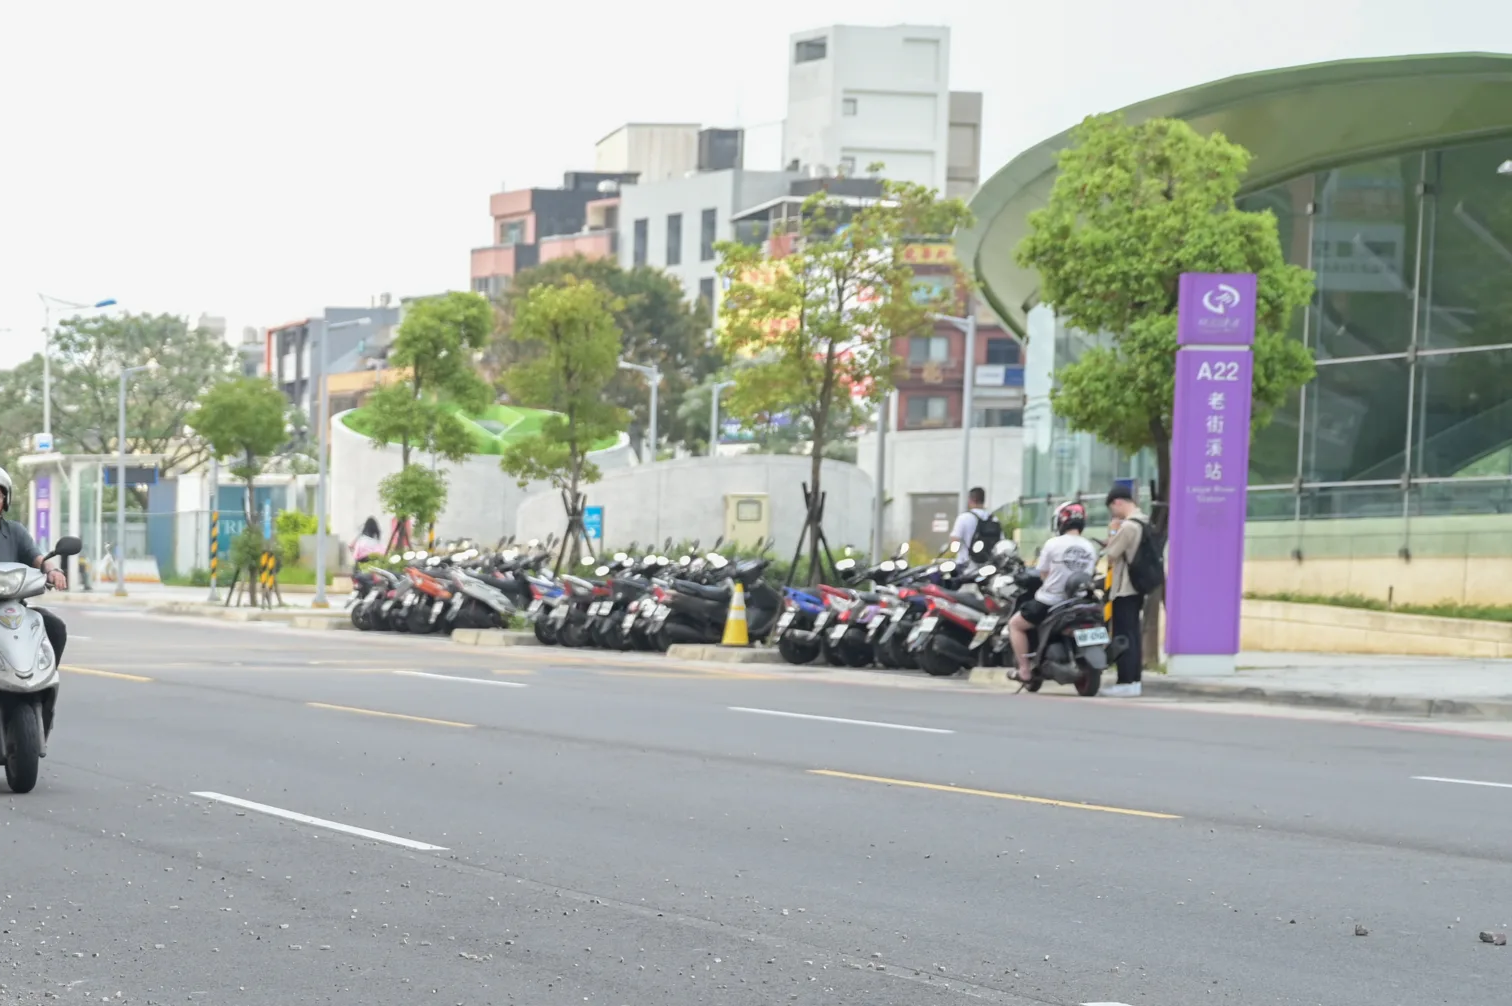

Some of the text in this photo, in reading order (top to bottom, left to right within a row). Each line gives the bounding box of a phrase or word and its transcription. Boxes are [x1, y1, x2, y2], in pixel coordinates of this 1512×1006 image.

[1196, 361, 1240, 381] A22
[1204, 391, 1226, 481] 老街溪站
